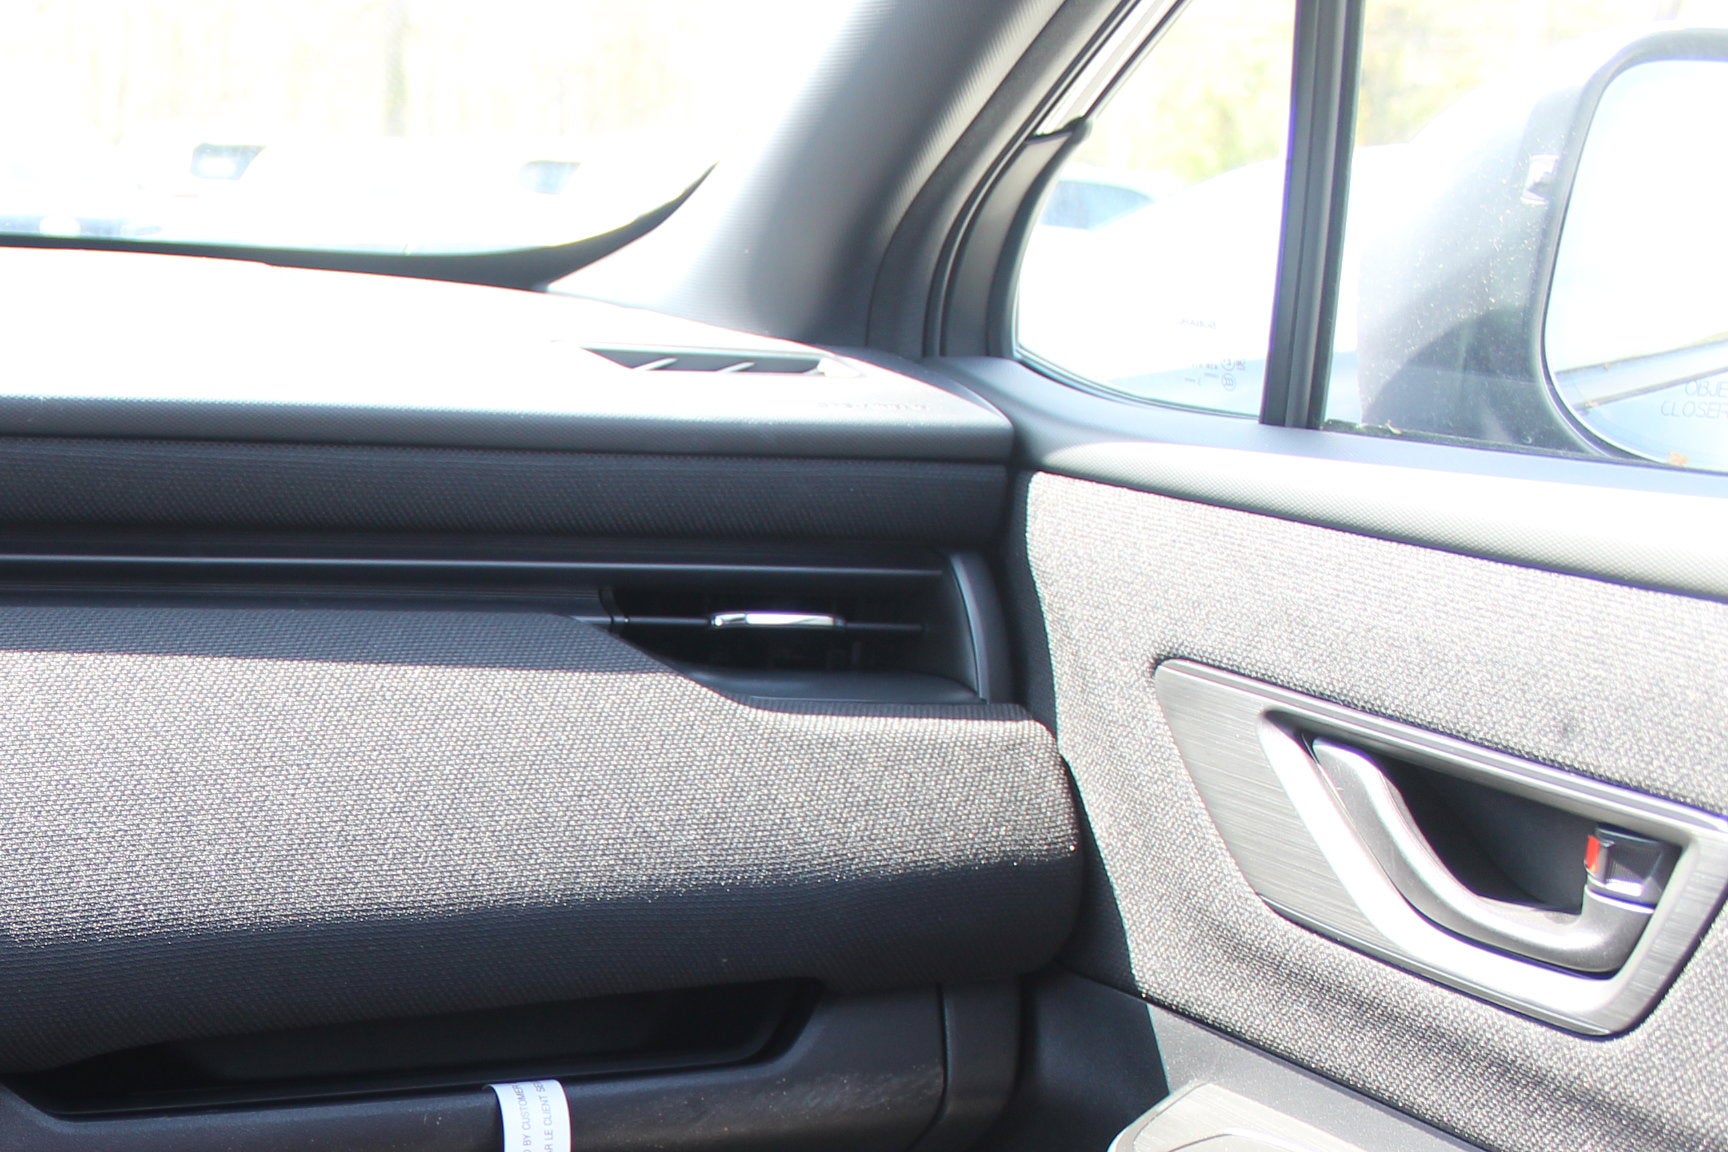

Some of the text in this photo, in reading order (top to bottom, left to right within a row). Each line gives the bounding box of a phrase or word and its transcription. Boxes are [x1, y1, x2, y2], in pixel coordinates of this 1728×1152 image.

[512, 1084, 531, 1131] CUSTOMER
[538, 1095, 552, 1127] CLIENT
[522, 1133, 532, 1146] BY
[544, 1129, 553, 1140] LE
